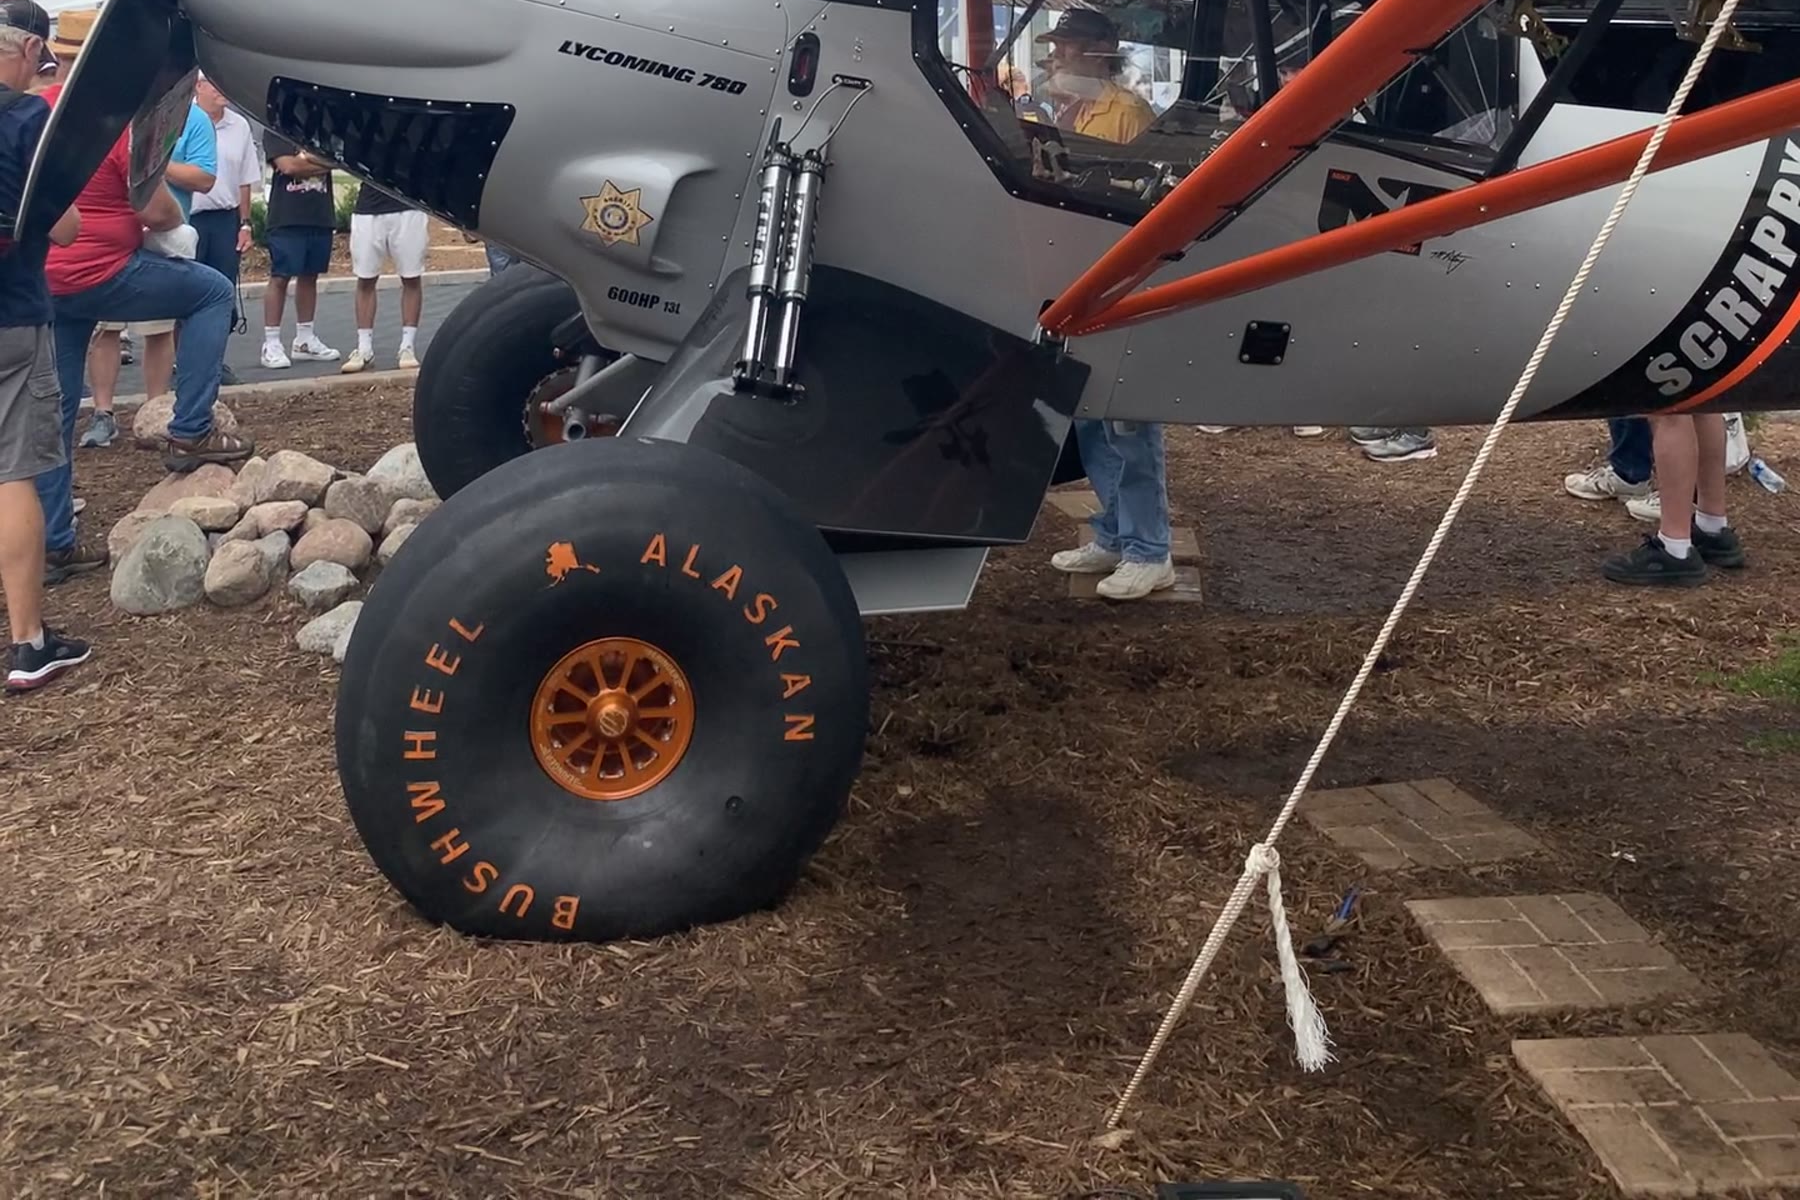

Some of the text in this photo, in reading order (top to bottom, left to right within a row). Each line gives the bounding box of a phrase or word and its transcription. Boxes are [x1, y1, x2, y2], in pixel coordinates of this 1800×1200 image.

[558, 40, 748, 96] LYCOMING 780
[607, 286, 681, 315] 600HP 13L
[639, 532, 815, 743] ALASKAN
[403, 616, 582, 931] BUSHWHEEL
